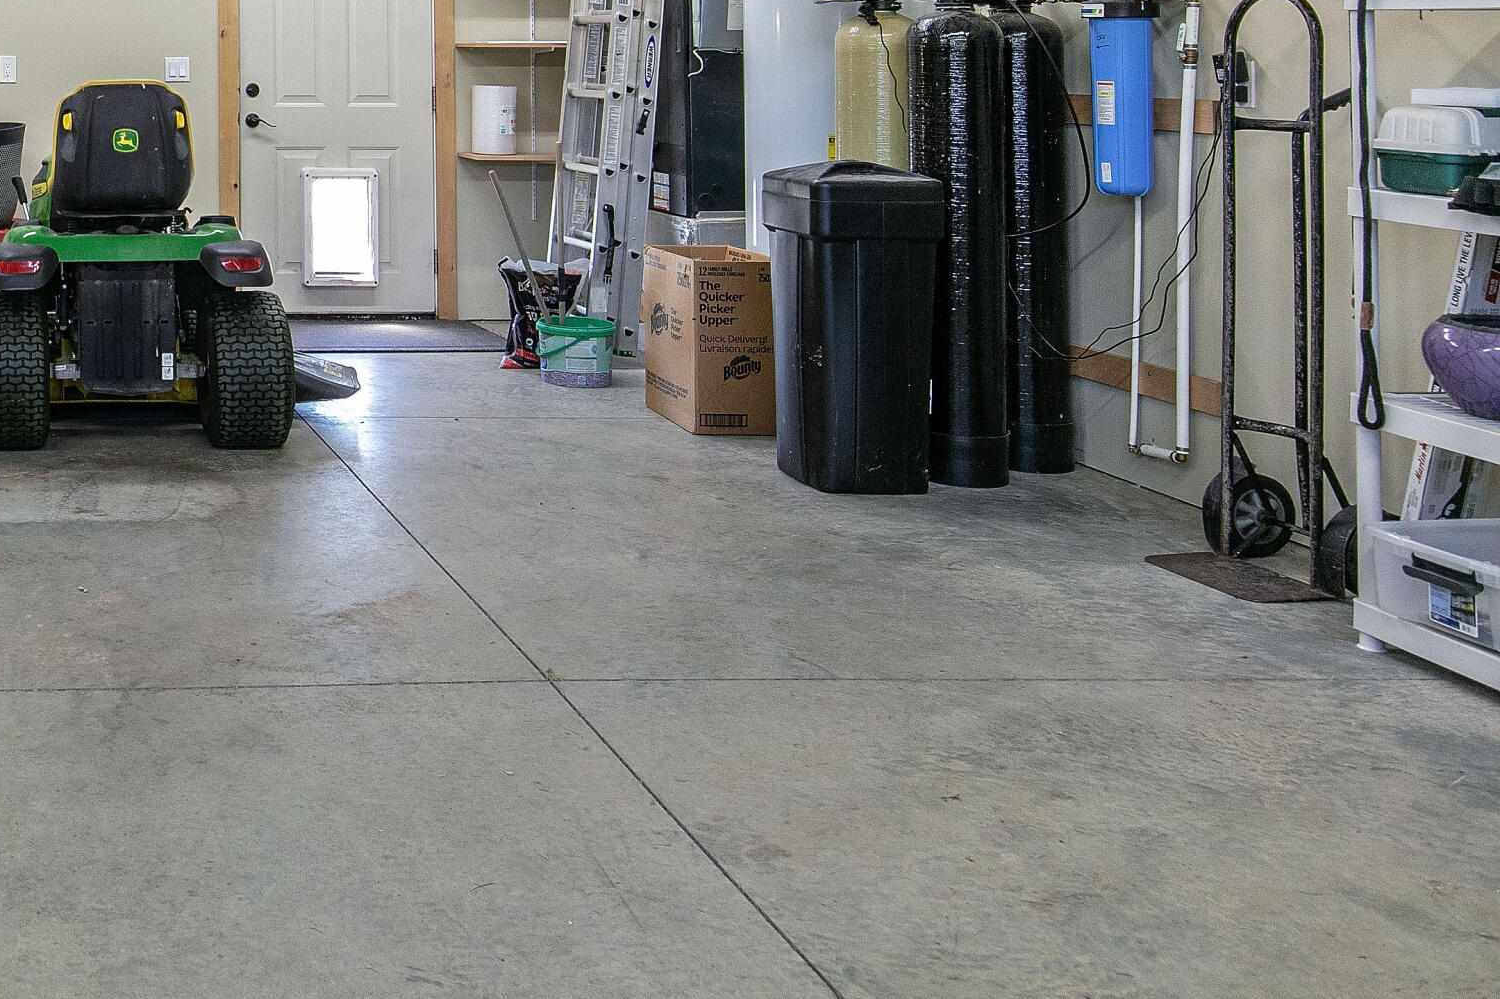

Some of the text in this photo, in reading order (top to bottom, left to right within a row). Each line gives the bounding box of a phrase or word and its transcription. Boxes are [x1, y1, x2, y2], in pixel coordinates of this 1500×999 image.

[646, 45, 654, 79] WERNER
[1450, 231, 1474, 308] LONG LIVE THE LEV
[698, 281, 721, 291] The
[698, 291, 745, 303] Quicker
[699, 303, 736, 314] Picker
[699, 314, 736, 328] Upper
[699, 334, 768, 346] Quick Delivery!
[699, 344, 741, 353] Livraison
[723, 359, 762, 382] Bounty
